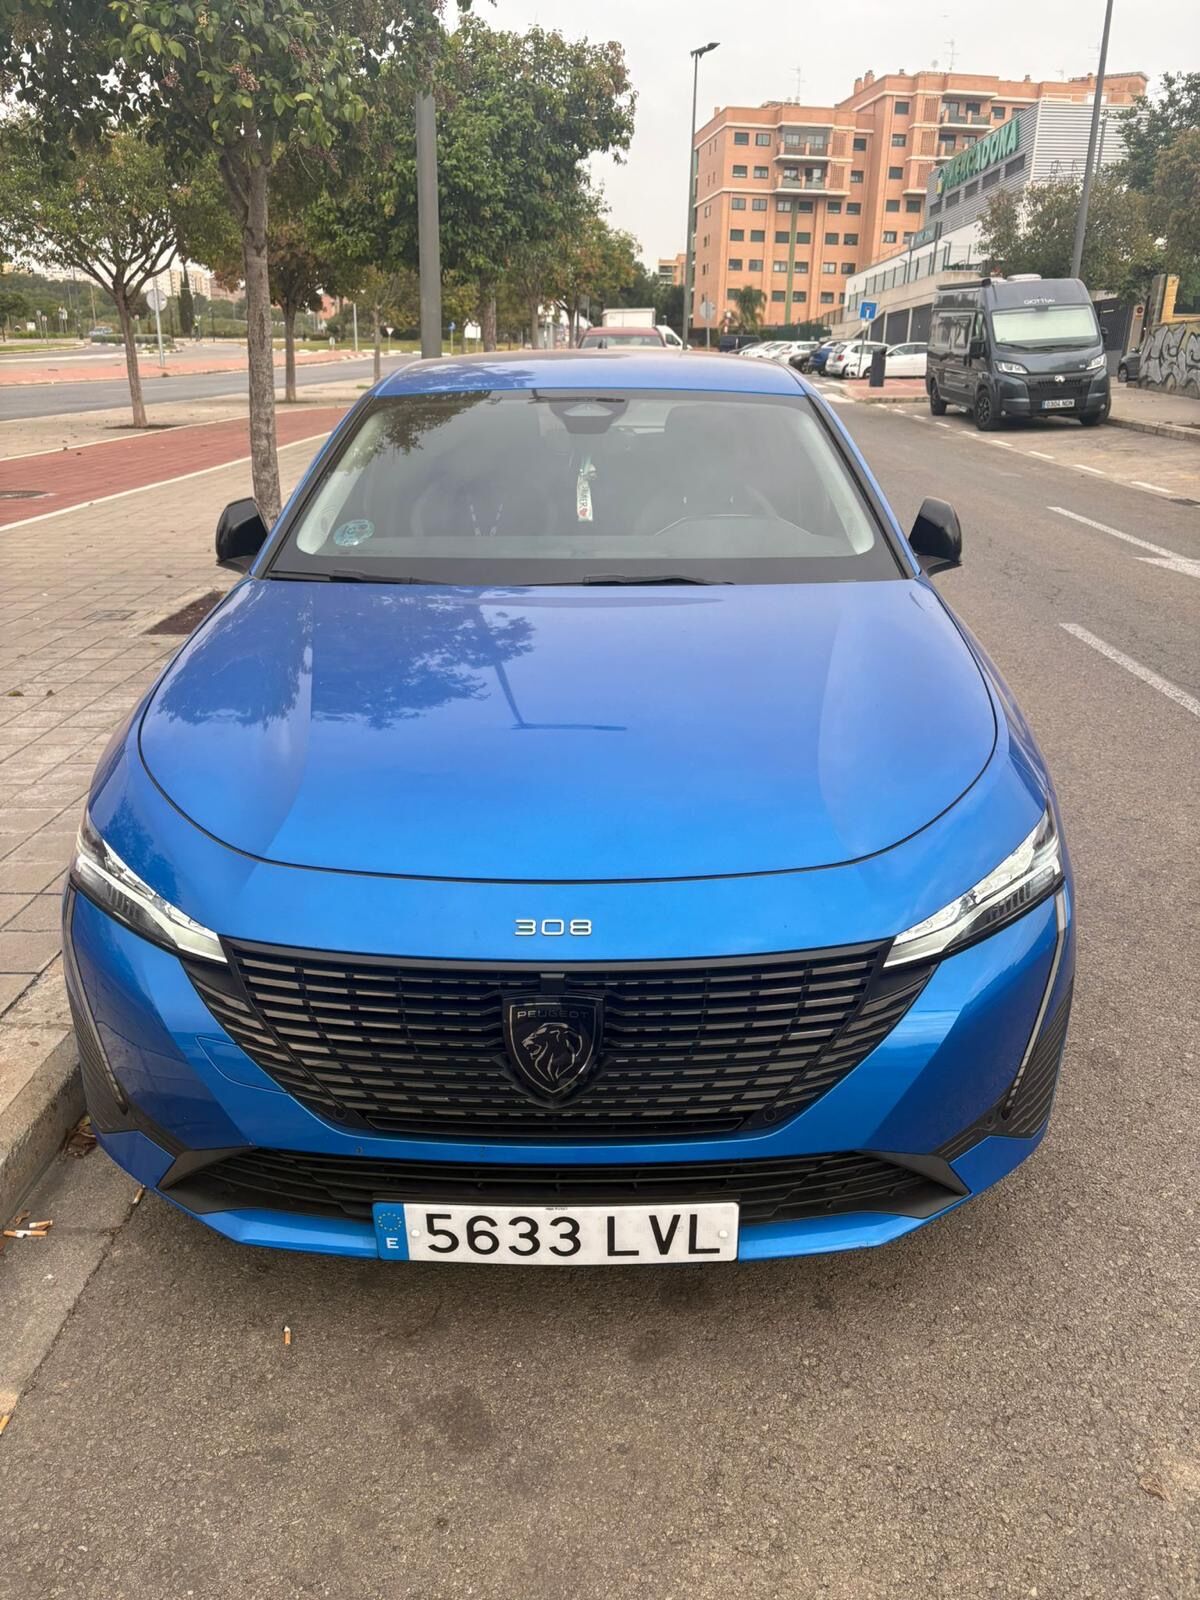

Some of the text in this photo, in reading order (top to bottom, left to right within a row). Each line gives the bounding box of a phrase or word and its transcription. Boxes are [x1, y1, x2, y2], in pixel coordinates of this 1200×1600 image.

[943, 117, 1019, 190] MERCADONA
[514, 918, 593, 936] 308
[517, 1010, 590, 1019] PEUGEOT
[386, 1237, 399, 1249] E
[425, 1213, 721, 1257] 5633 LVL
